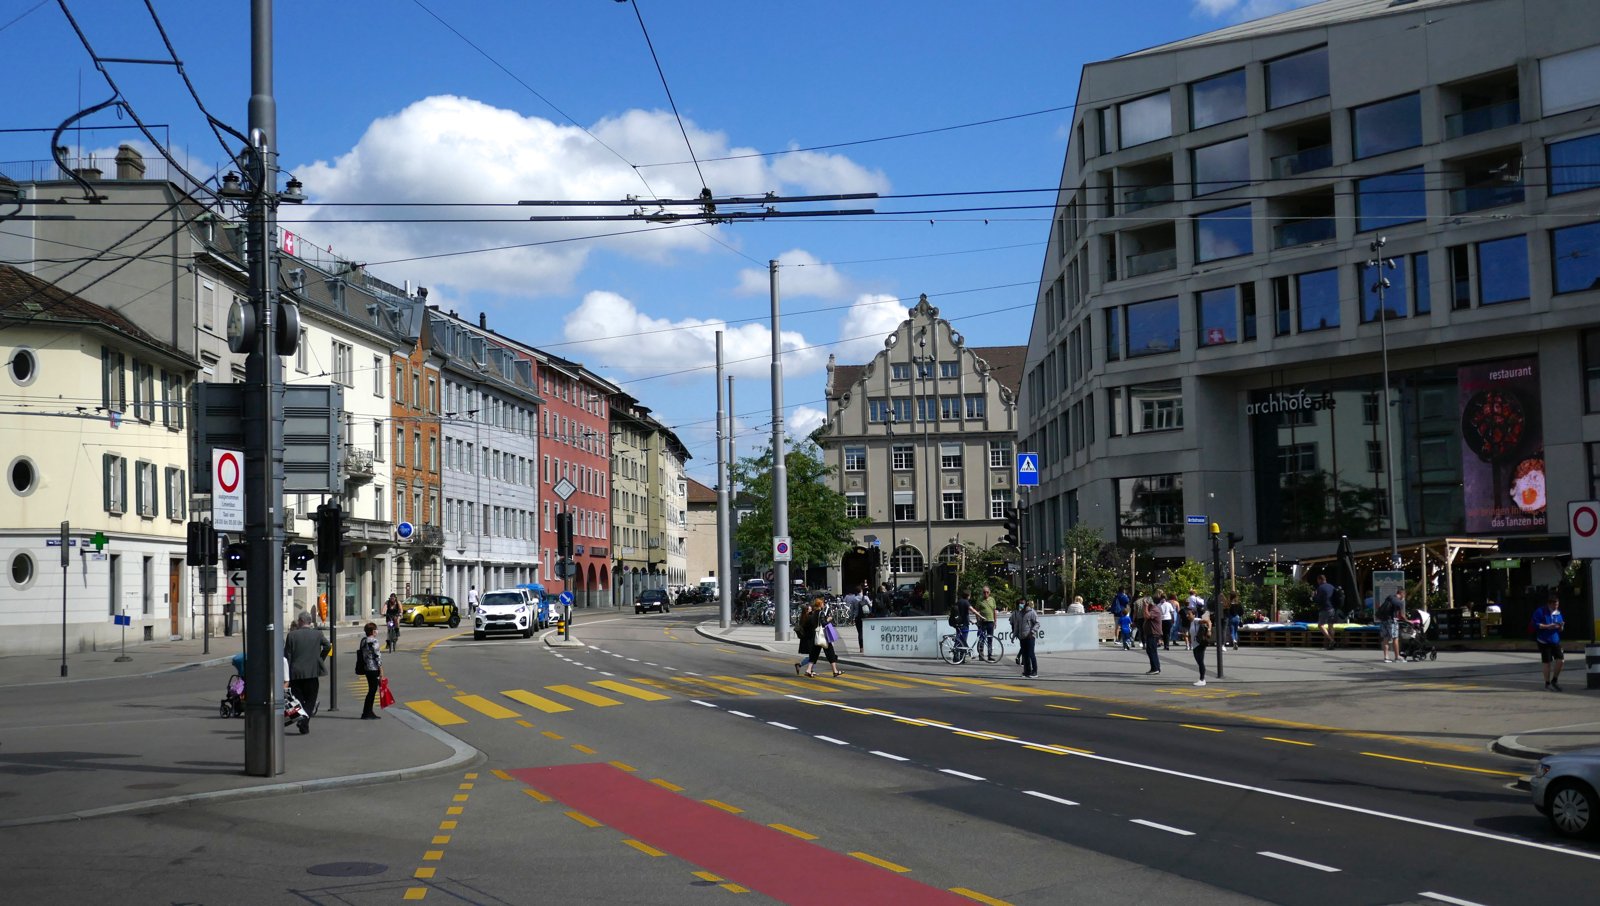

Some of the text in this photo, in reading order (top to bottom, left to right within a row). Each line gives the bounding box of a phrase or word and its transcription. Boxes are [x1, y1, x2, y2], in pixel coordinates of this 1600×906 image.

[1489, 366, 1532, 380] restaurant
[1491, 513, 1546, 527] das Tanzen bei
